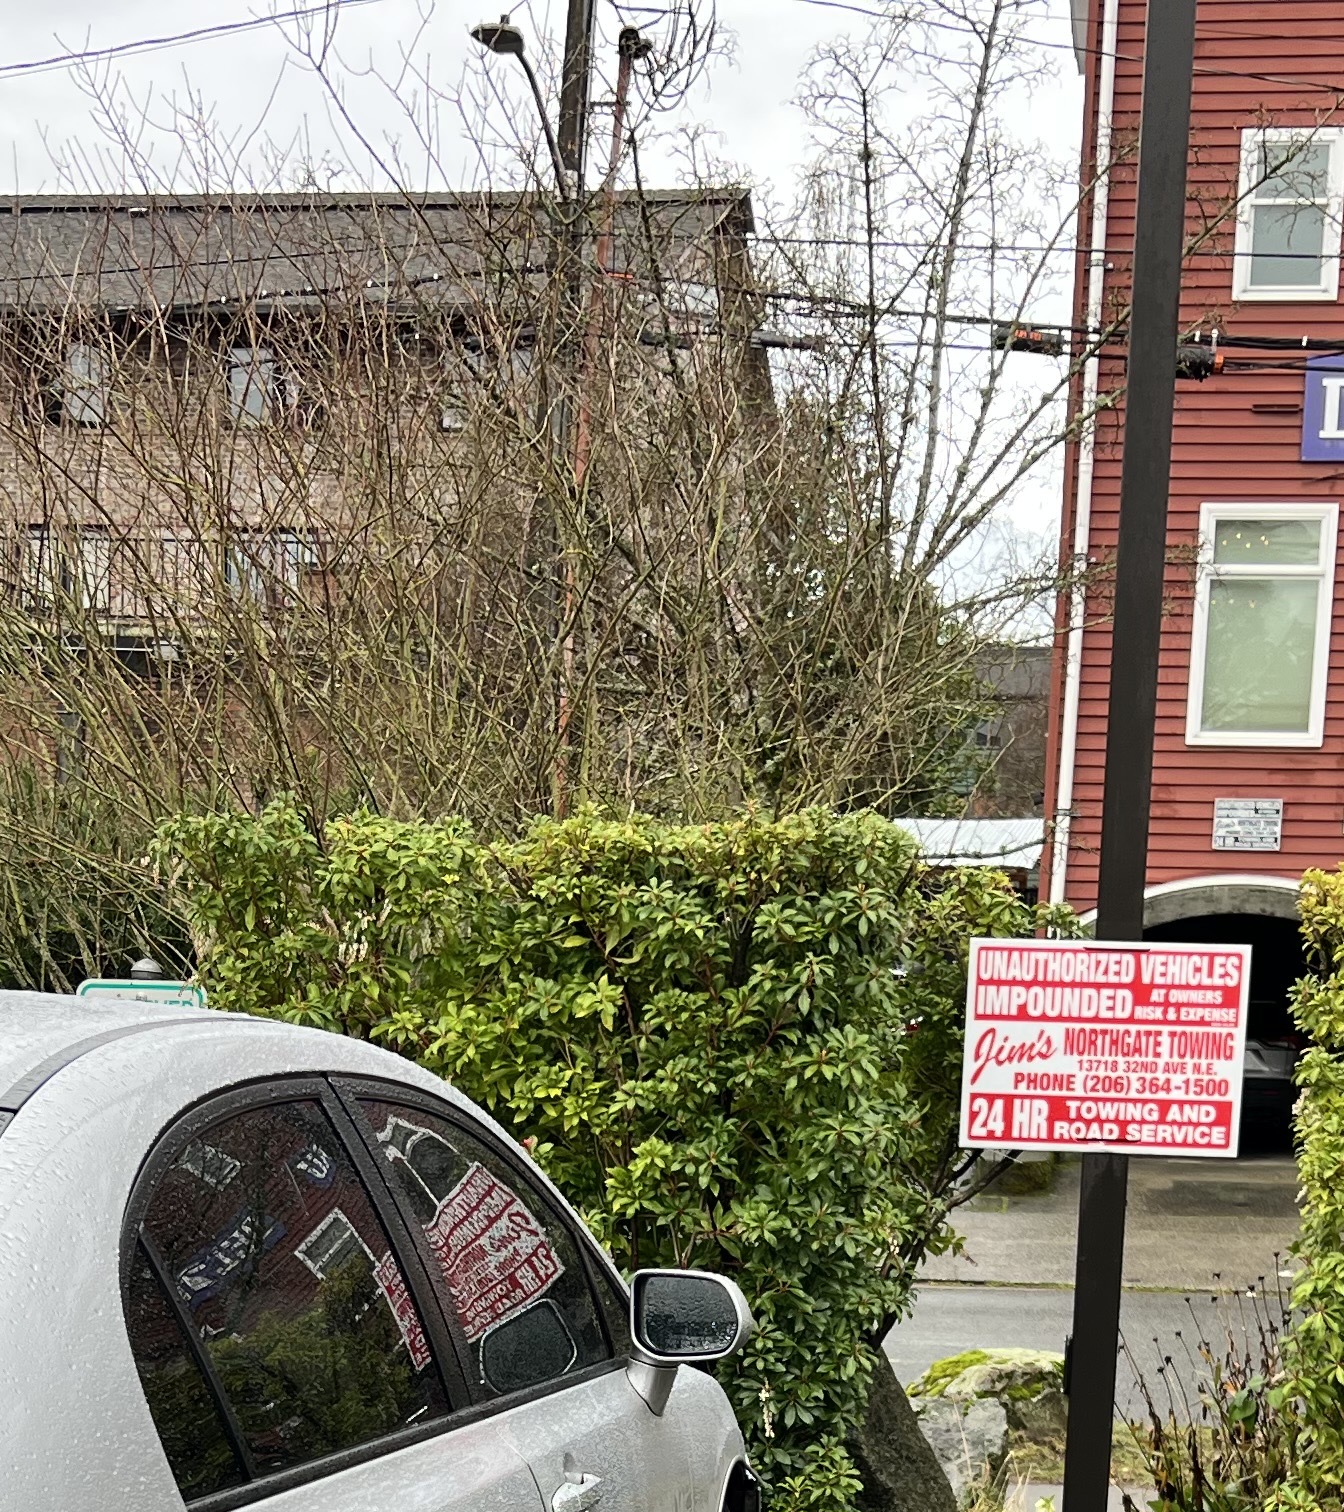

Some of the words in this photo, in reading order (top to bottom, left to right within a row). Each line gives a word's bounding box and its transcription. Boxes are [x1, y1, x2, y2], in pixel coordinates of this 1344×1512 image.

[978, 950, 1135, 984] UNAUTHORIZED
[1140, 953, 1240, 987] VEHICLES
[976, 985, 1133, 1019] IMPOUNDED
[1150, 989, 1167, 1003] AT
[1169, 989, 1223, 1005] OWNERS
[1134, 1005, 1165, 1021] RISK
[1166, 1007, 1177, 1021] &
[1180, 1007, 1237, 1023] EXPENSE
[970, 1027, 1058, 1086] Jim's
[1063, 1027, 1162, 1059] NORTHGATE
[1168, 1030, 1234, 1061] TOWING
[1077, 1059, 1118, 1073] 13718
[1123, 1060, 1158, 1074] 32ND
[1162, 1061, 1187, 1075] AVE
[1192, 1062, 1217, 1076] N.E.
[1014, 1072, 1076, 1092] PHONE
[1083, 1074, 1131, 1095] (206)
[1136, 1076, 1229, 1097] 364-1500
[970, 1097, 1005, 1138] 24
[1011, 1098, 1049, 1139] HR
[1065, 1100, 1159, 1122] TOWING
[1165, 1103, 1217, 1124] AND
[1053, 1120, 1119, 1140] ROAD
[1125, 1122, 1227, 1145] SERVICE
